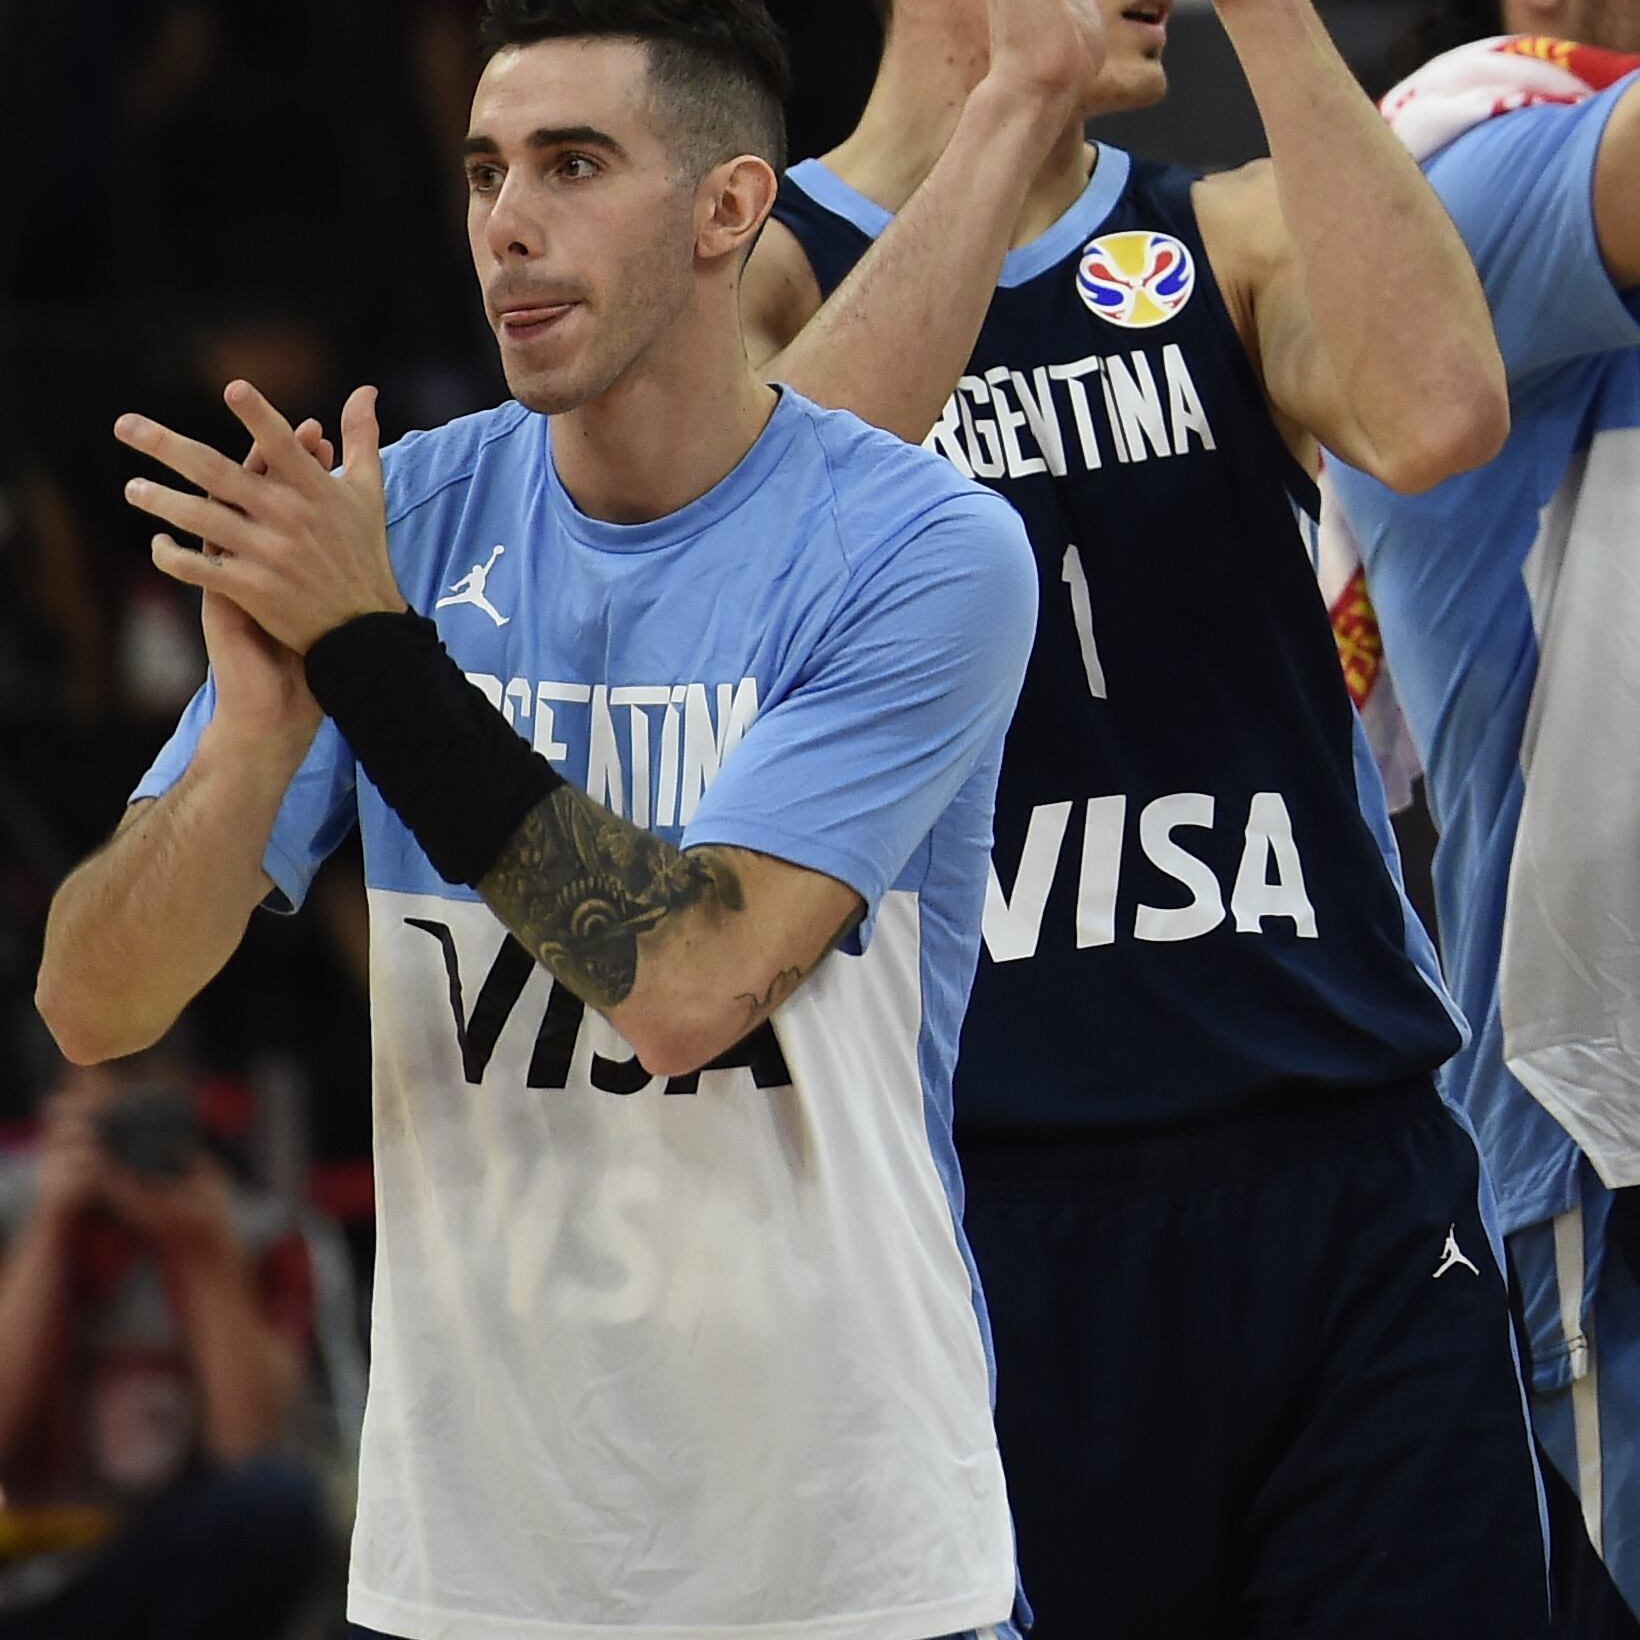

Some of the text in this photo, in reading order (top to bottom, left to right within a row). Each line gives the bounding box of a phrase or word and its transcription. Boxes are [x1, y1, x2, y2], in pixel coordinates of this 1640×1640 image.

[920, 343, 1217, 479] RGENTINA
[1061, 543, 1107, 700] 1
[980, 791, 1320, 963] VISA
